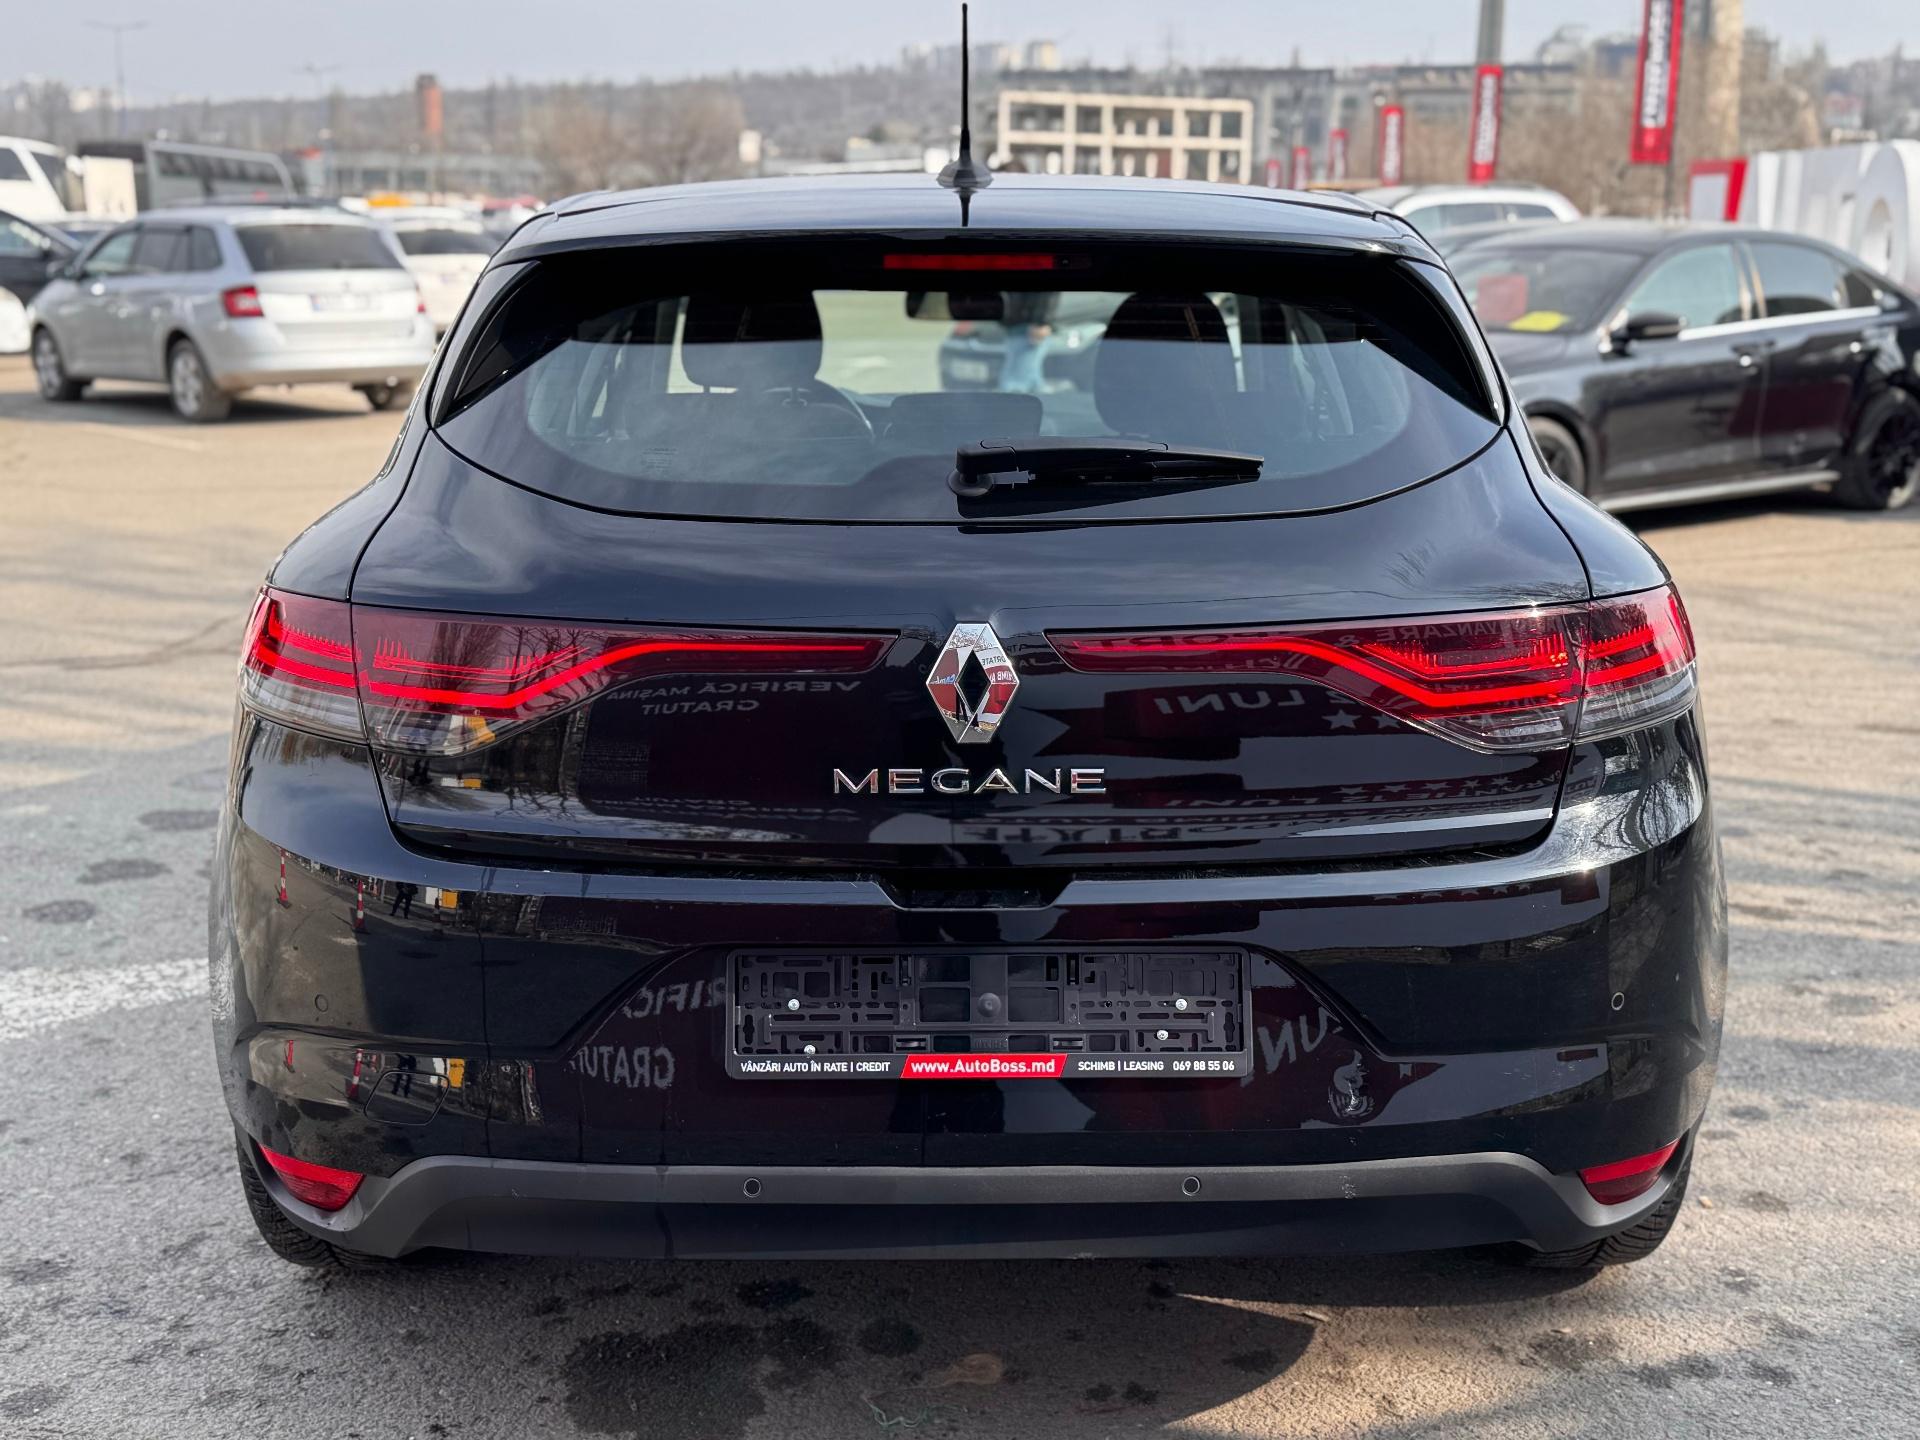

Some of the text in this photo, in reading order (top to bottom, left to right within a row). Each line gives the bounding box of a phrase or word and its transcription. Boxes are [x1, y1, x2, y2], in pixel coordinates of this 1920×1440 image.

[833, 768, 1107, 794] MEGANE
[740, 1060, 781, 1072] VÂNZĂRI
[783, 1062, 808, 1072] AUTO
[810, 1060, 821, 1072] ÎN
[823, 1061, 848, 1072] RATE
[856, 1061, 890, 1072] CREDIT
[911, 1059, 1055, 1073] www.AutoBoss.md
[1078, 1060, 1115, 1071] SCHIMB
[1123, 1060, 1164, 1071] LEASING
[1172, 1060, 1191, 1071] 069
[1193, 1060, 1205, 1071] 88
[1208, 1060, 1220, 1071] 55
[1222, 1060, 1235, 1071] 06
